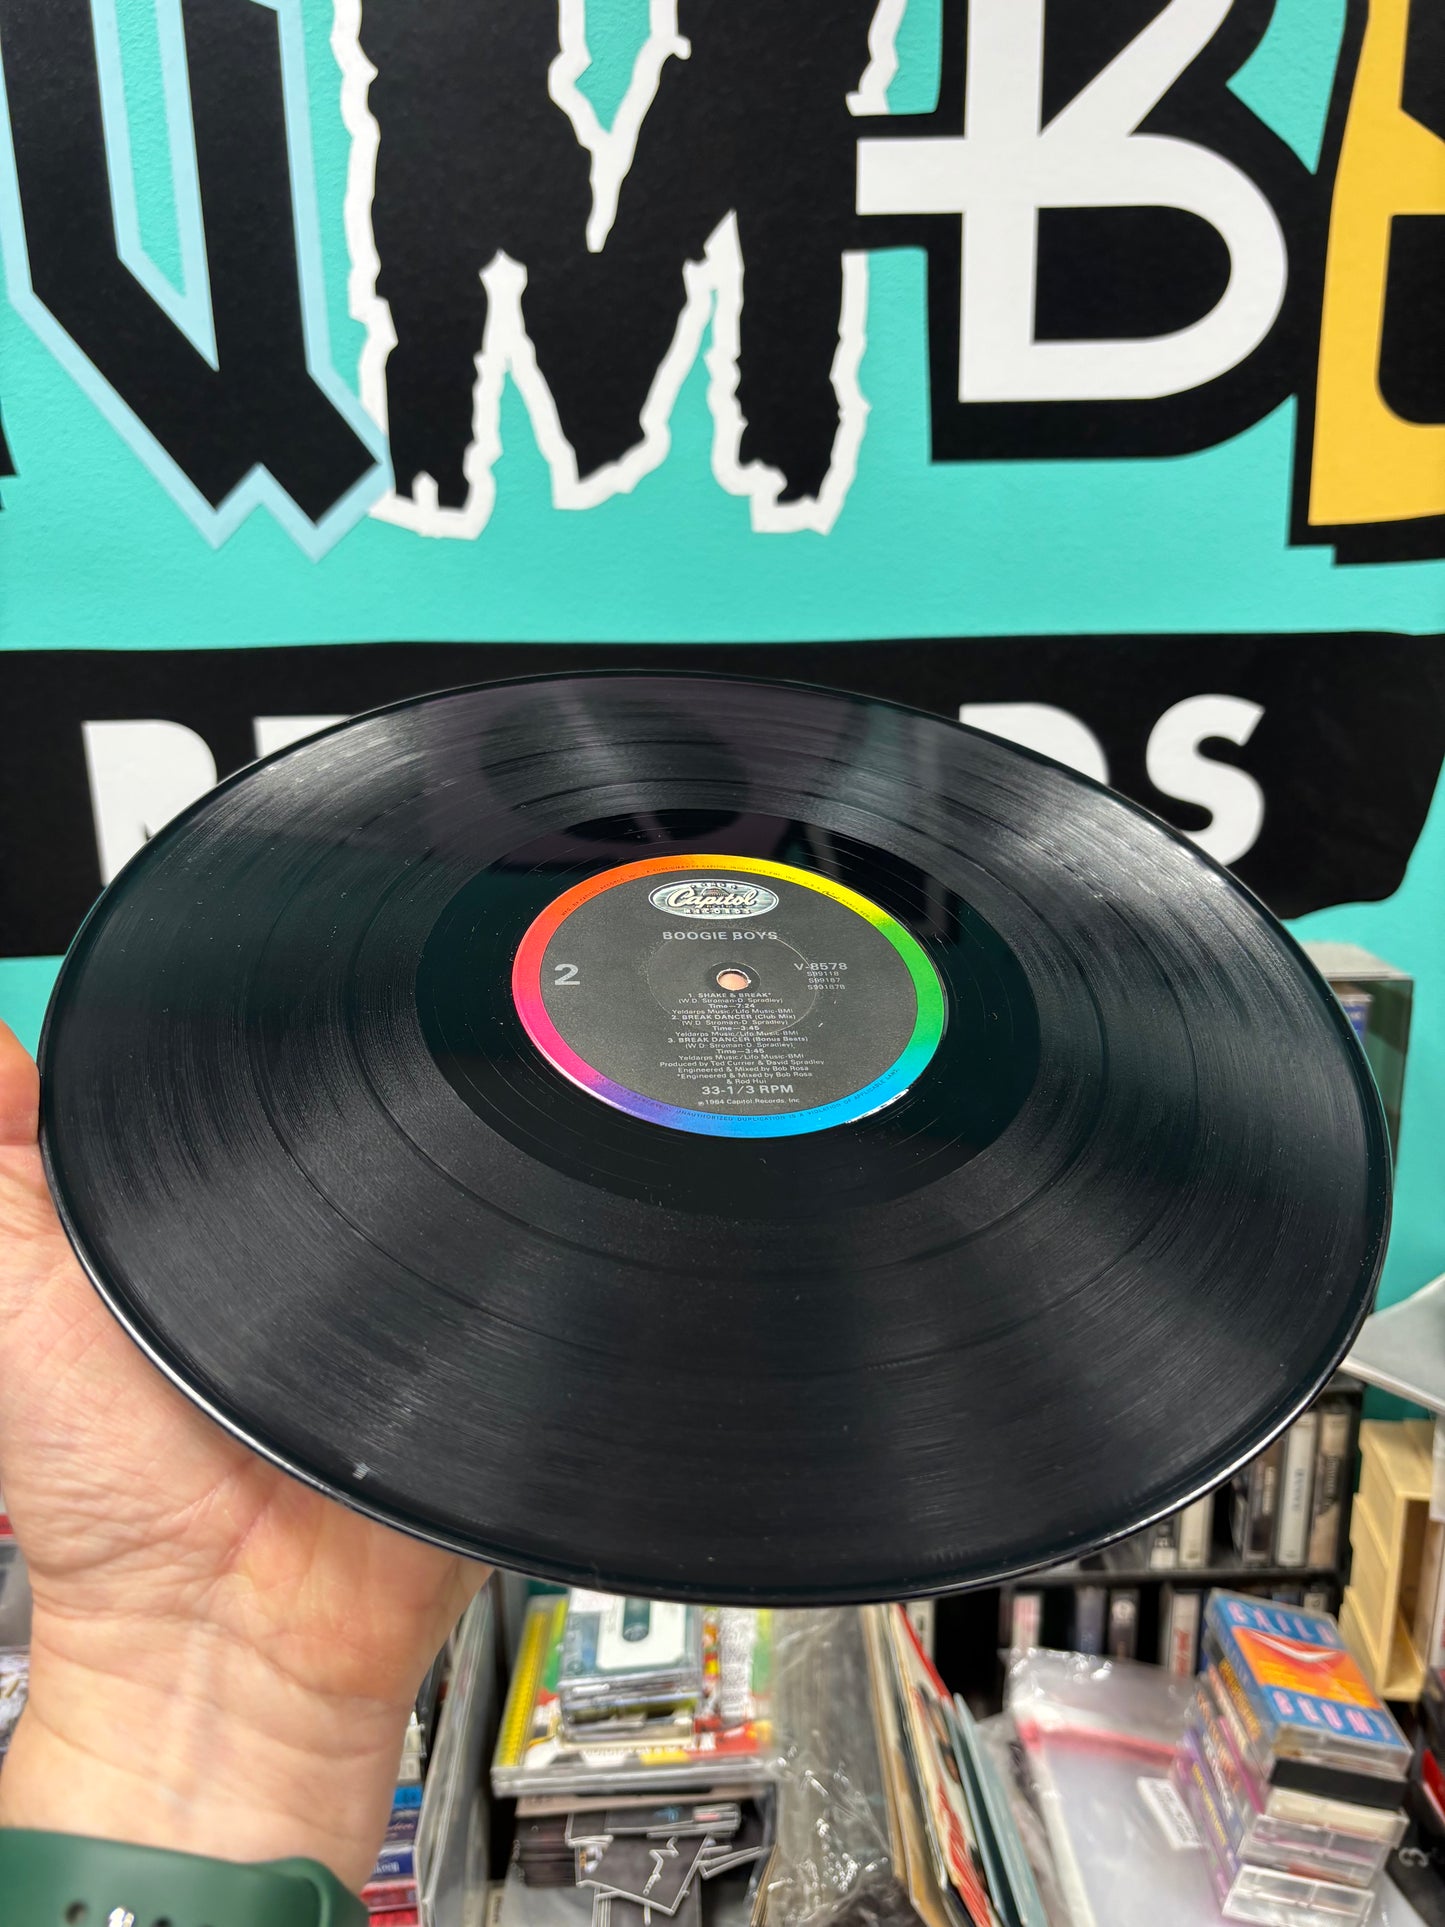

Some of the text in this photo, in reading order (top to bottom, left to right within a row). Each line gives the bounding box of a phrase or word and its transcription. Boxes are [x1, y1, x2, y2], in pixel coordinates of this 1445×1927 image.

[667, 887, 758, 908] Capitol
[662, 931, 778, 940] BOOGIE BOYS
[793, 962, 848, 971] V-8578
[554, 963, 581, 986] 2
[701, 1084, 794, 1095] 33-1/3 RPM
[676, 1108, 733, 1122] UNAUTHORIZED
[807, 1103, 842, 1115] VIOLATION
